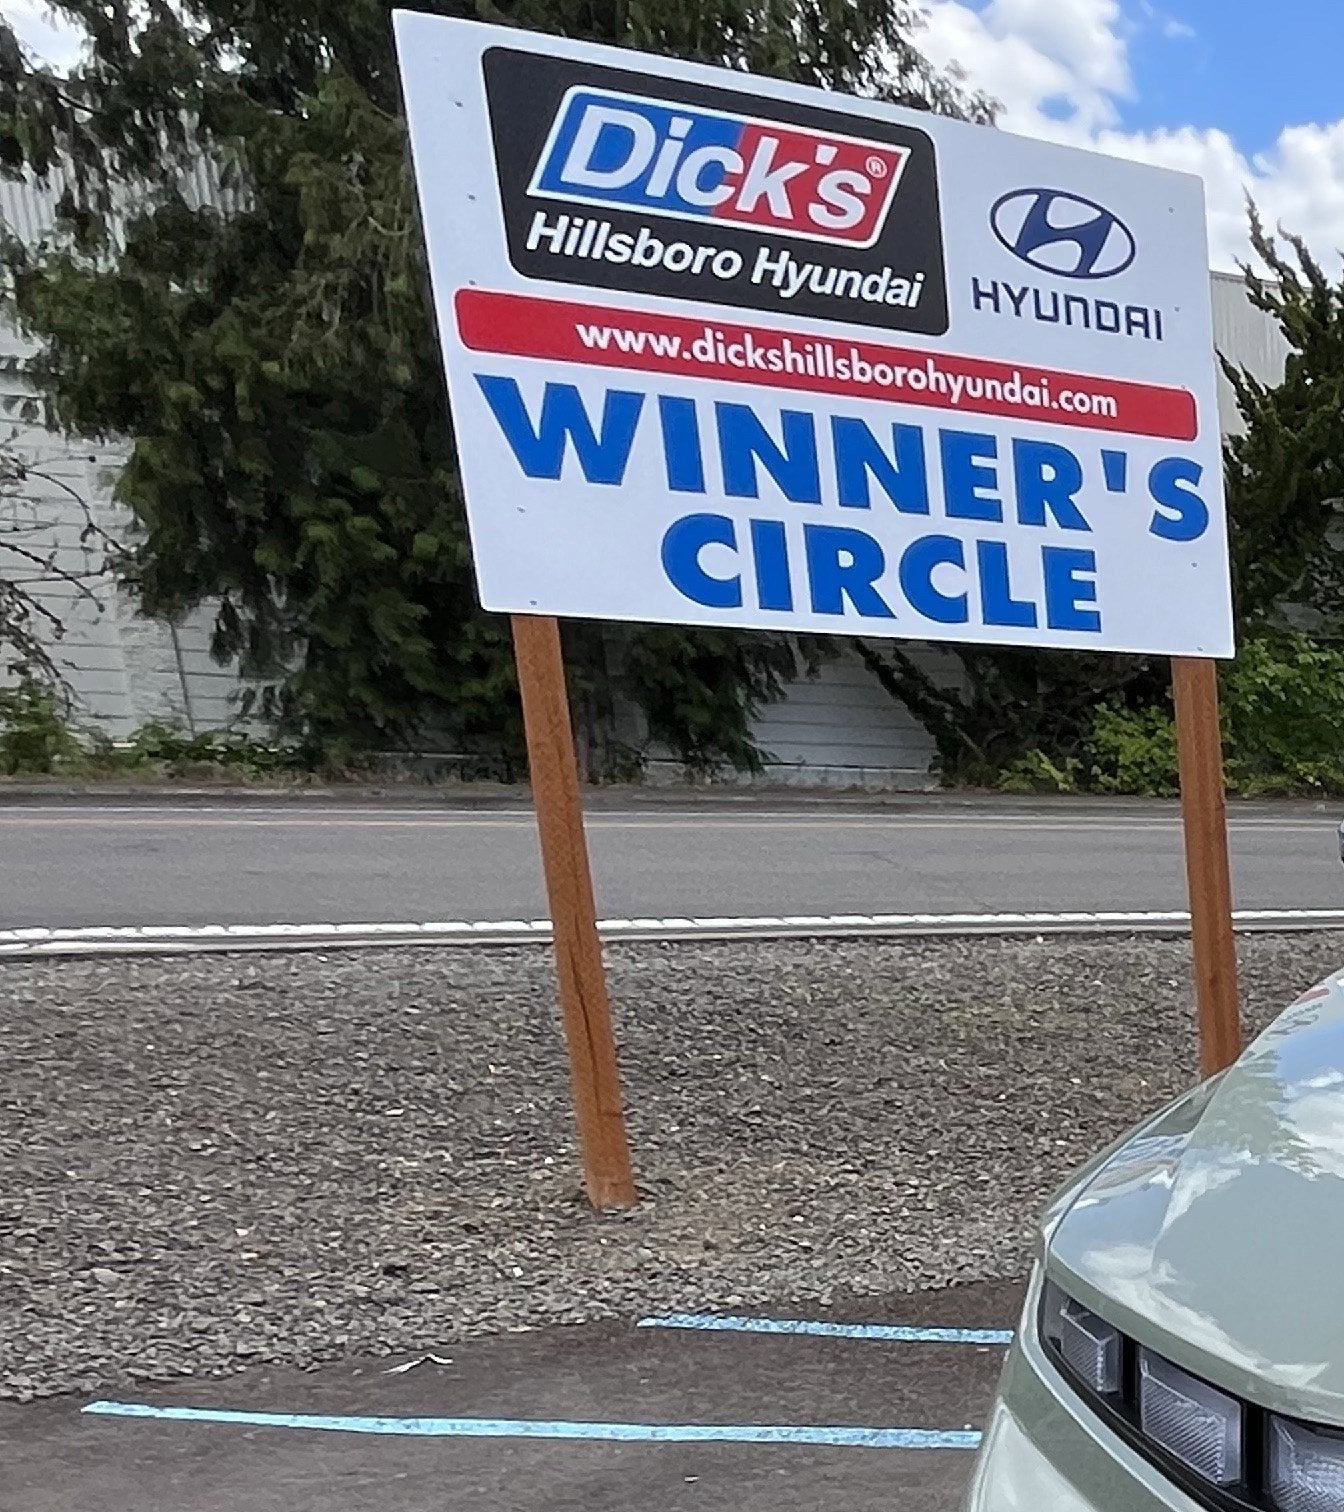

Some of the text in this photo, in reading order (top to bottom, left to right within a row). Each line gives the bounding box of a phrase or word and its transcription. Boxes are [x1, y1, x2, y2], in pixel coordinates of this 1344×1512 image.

[560, 104, 871, 231] Dick's
[526, 211, 926, 309] Hillsboro Hyundai
[972, 276, 1164, 341] HYUNDAI
[576, 320, 1119, 419] www.dickshillsborohyundai.com
[473, 373, 1210, 543] WINNER'S
[661, 512, 1102, 633] CIRCLE
